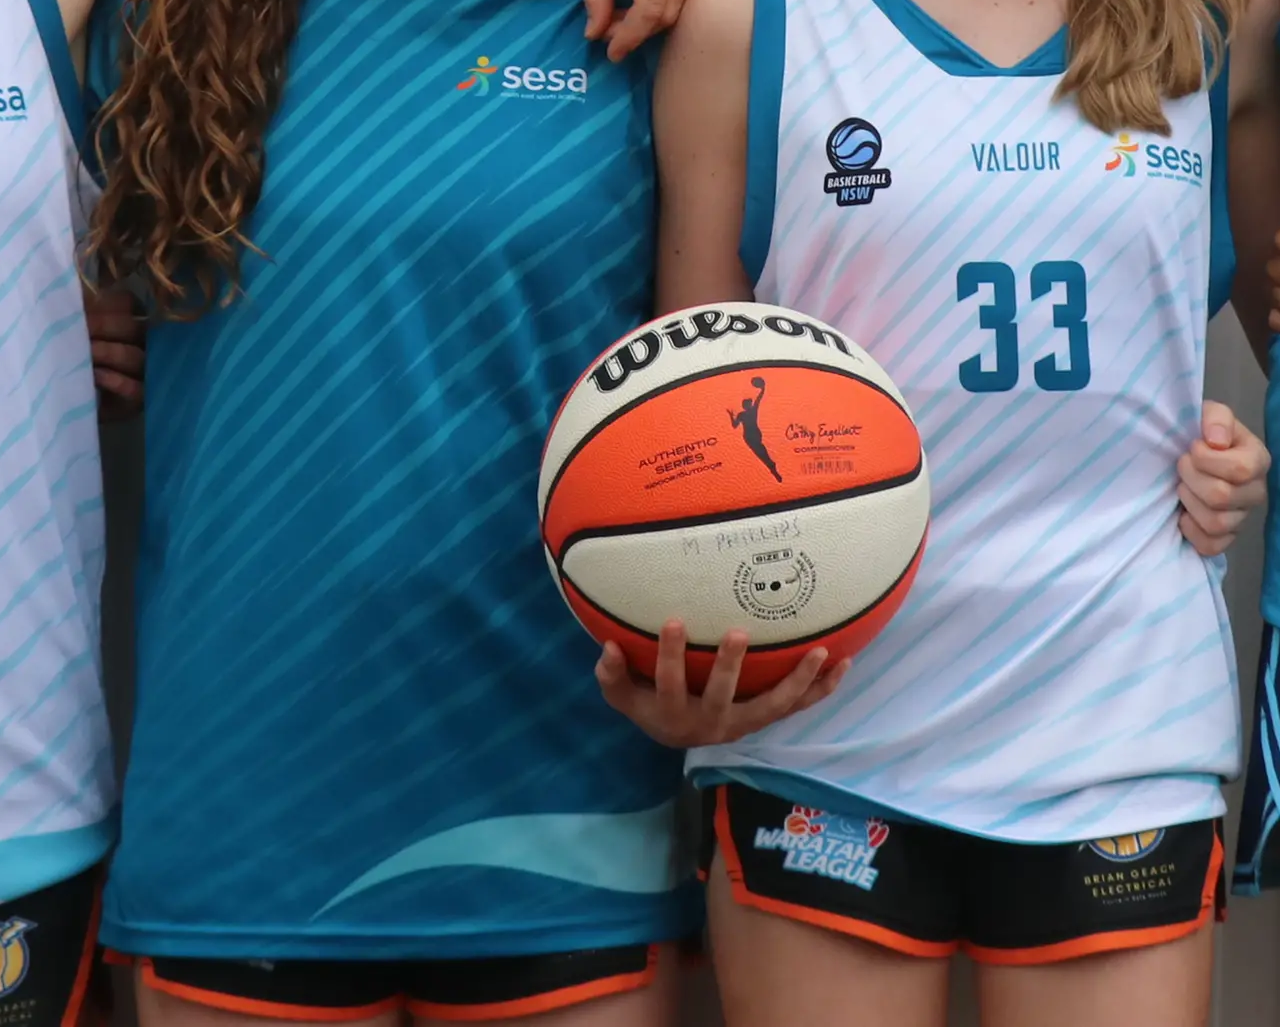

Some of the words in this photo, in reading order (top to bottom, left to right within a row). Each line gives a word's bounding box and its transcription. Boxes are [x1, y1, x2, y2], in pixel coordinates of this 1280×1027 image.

[501, 65, 588, 93] sesa
[971, 141, 1061, 172] VALOUR
[1146, 144, 1203, 179] sesa
[827, 173, 887, 189] BASKETBALL
[840, 186, 871, 201] NSW
[956, 260, 1091, 393] 33
[587, 310, 861, 393] Wilson
[638, 437, 718, 469] AUTHENTIC
[655, 452, 705, 475] SERIES
[754, 827, 878, 863] WARATAH
[783, 850, 878, 891] LEAGUE
[1084, 871, 1124, 885] BRIAN
[1092, 876, 1172, 898] ELECTRICAL
